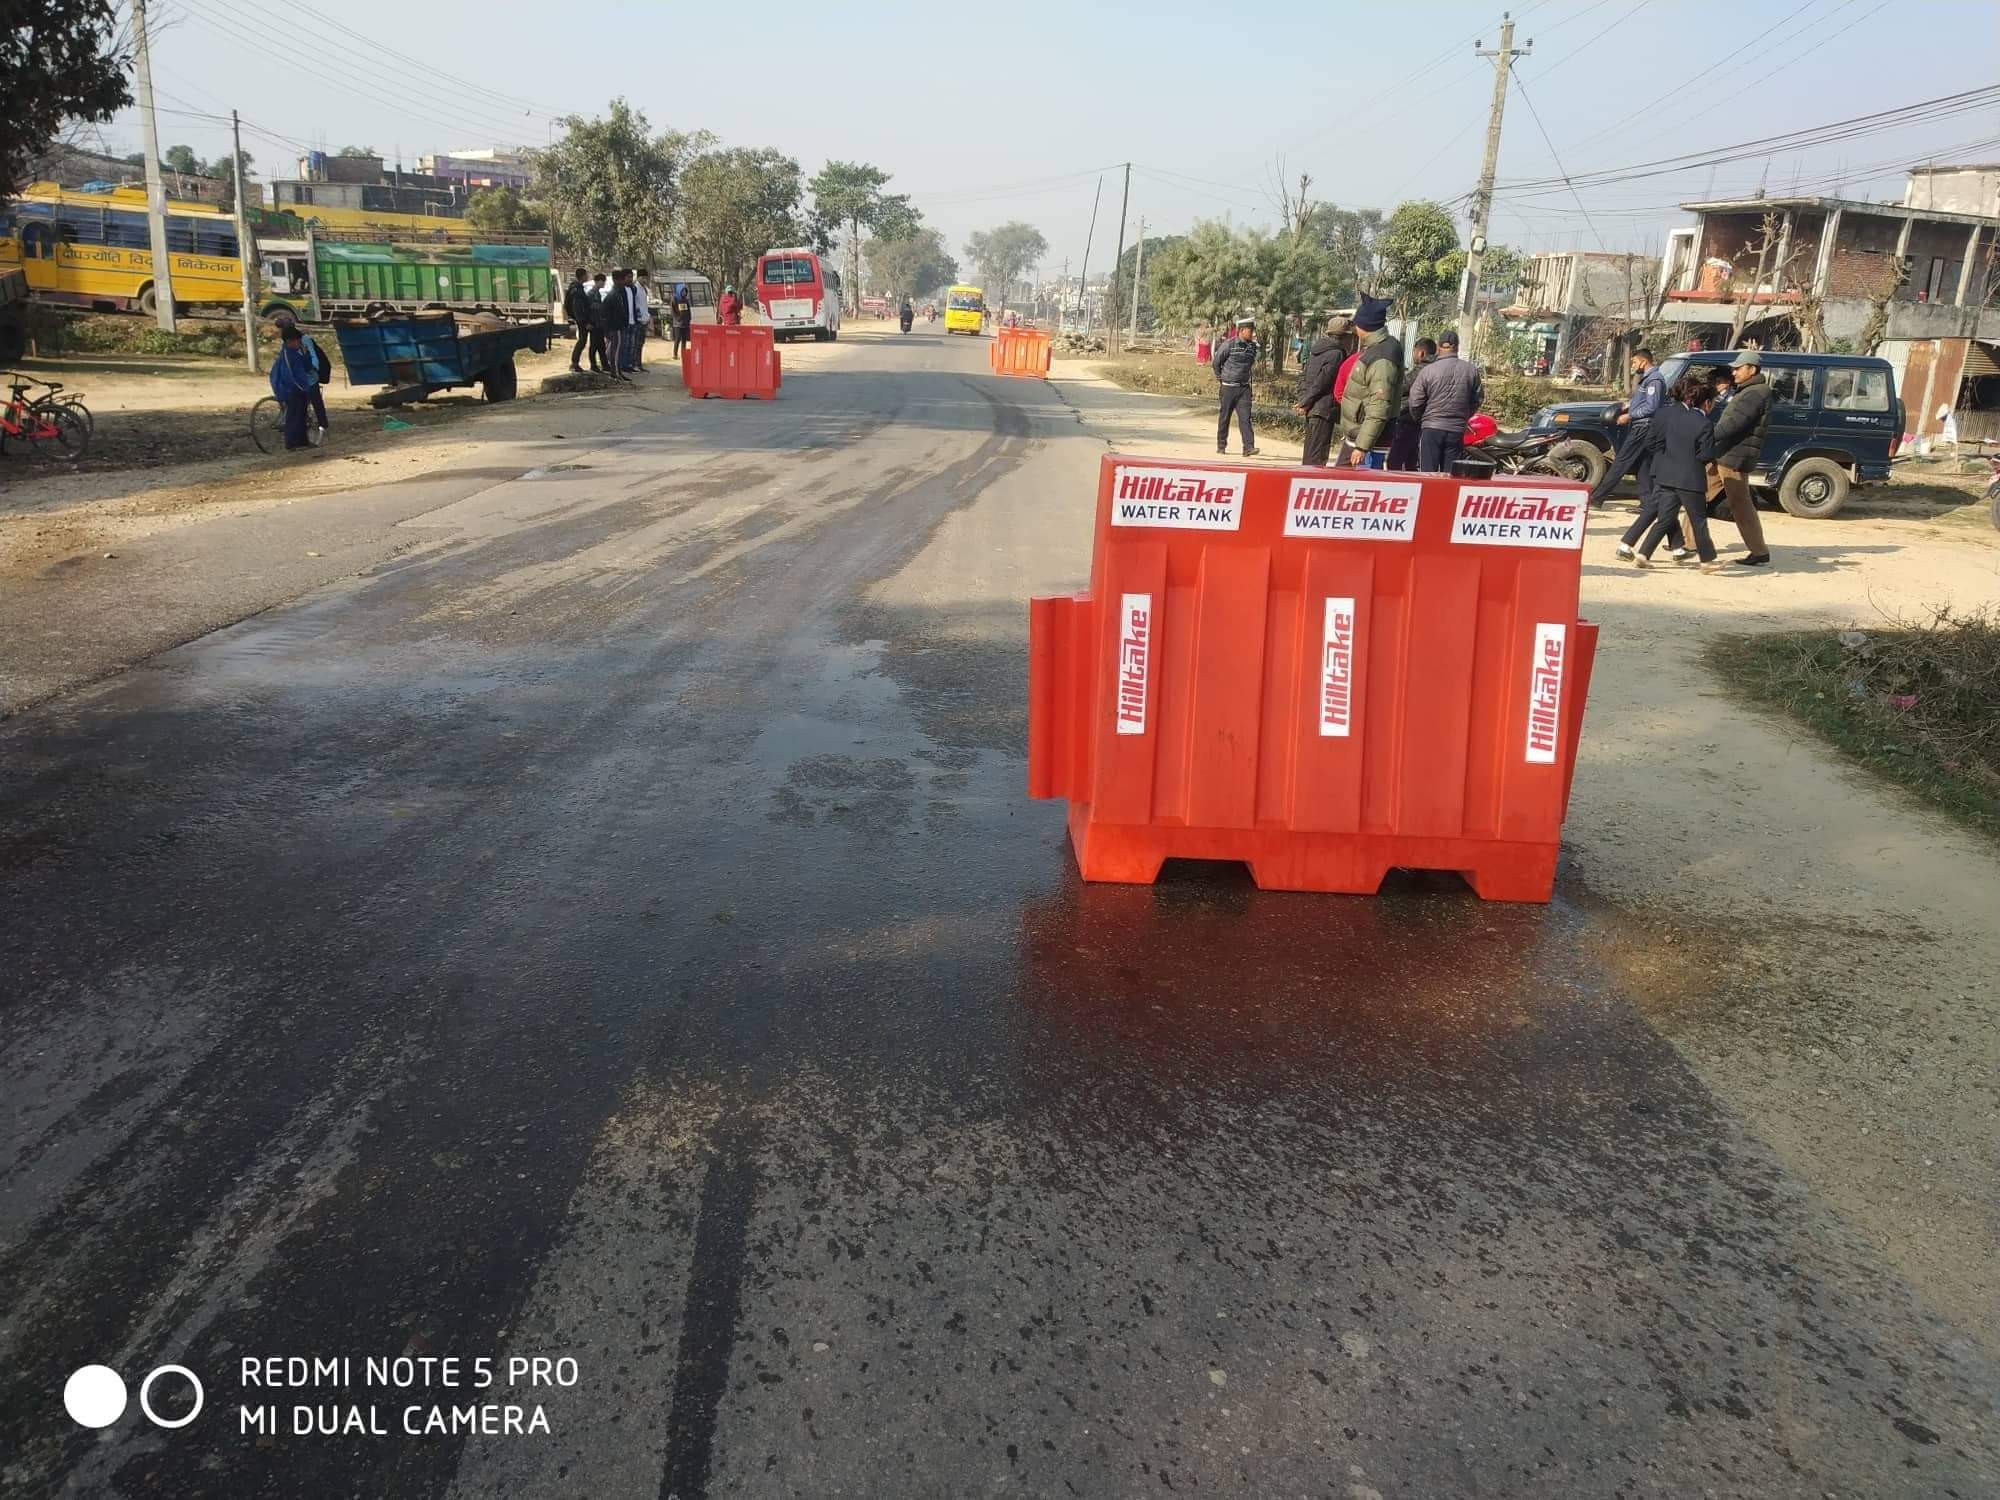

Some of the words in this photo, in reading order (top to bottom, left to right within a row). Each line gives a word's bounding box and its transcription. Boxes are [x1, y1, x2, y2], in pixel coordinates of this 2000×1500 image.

[178, 257, 234, 272] निकेतन
[1119, 475, 1234, 504] Hilltake
[1293, 487, 1409, 514] Hilltake
[1121, 505, 1180, 520] WATER
[1187, 507, 1232, 522] TANK
[1461, 495, 1576, 522] Hilltake
[1295, 515, 1354, 530] WATER
[1361, 518, 1406, 532] TANK
[1462, 523, 1521, 538] WATER
[1528, 526, 1574, 540] TANK
[1120, 609, 1147, 723] Hilltake
[1324, 613, 1351, 726] Hilltake
[1530, 639, 1562, 751] Hilltake
